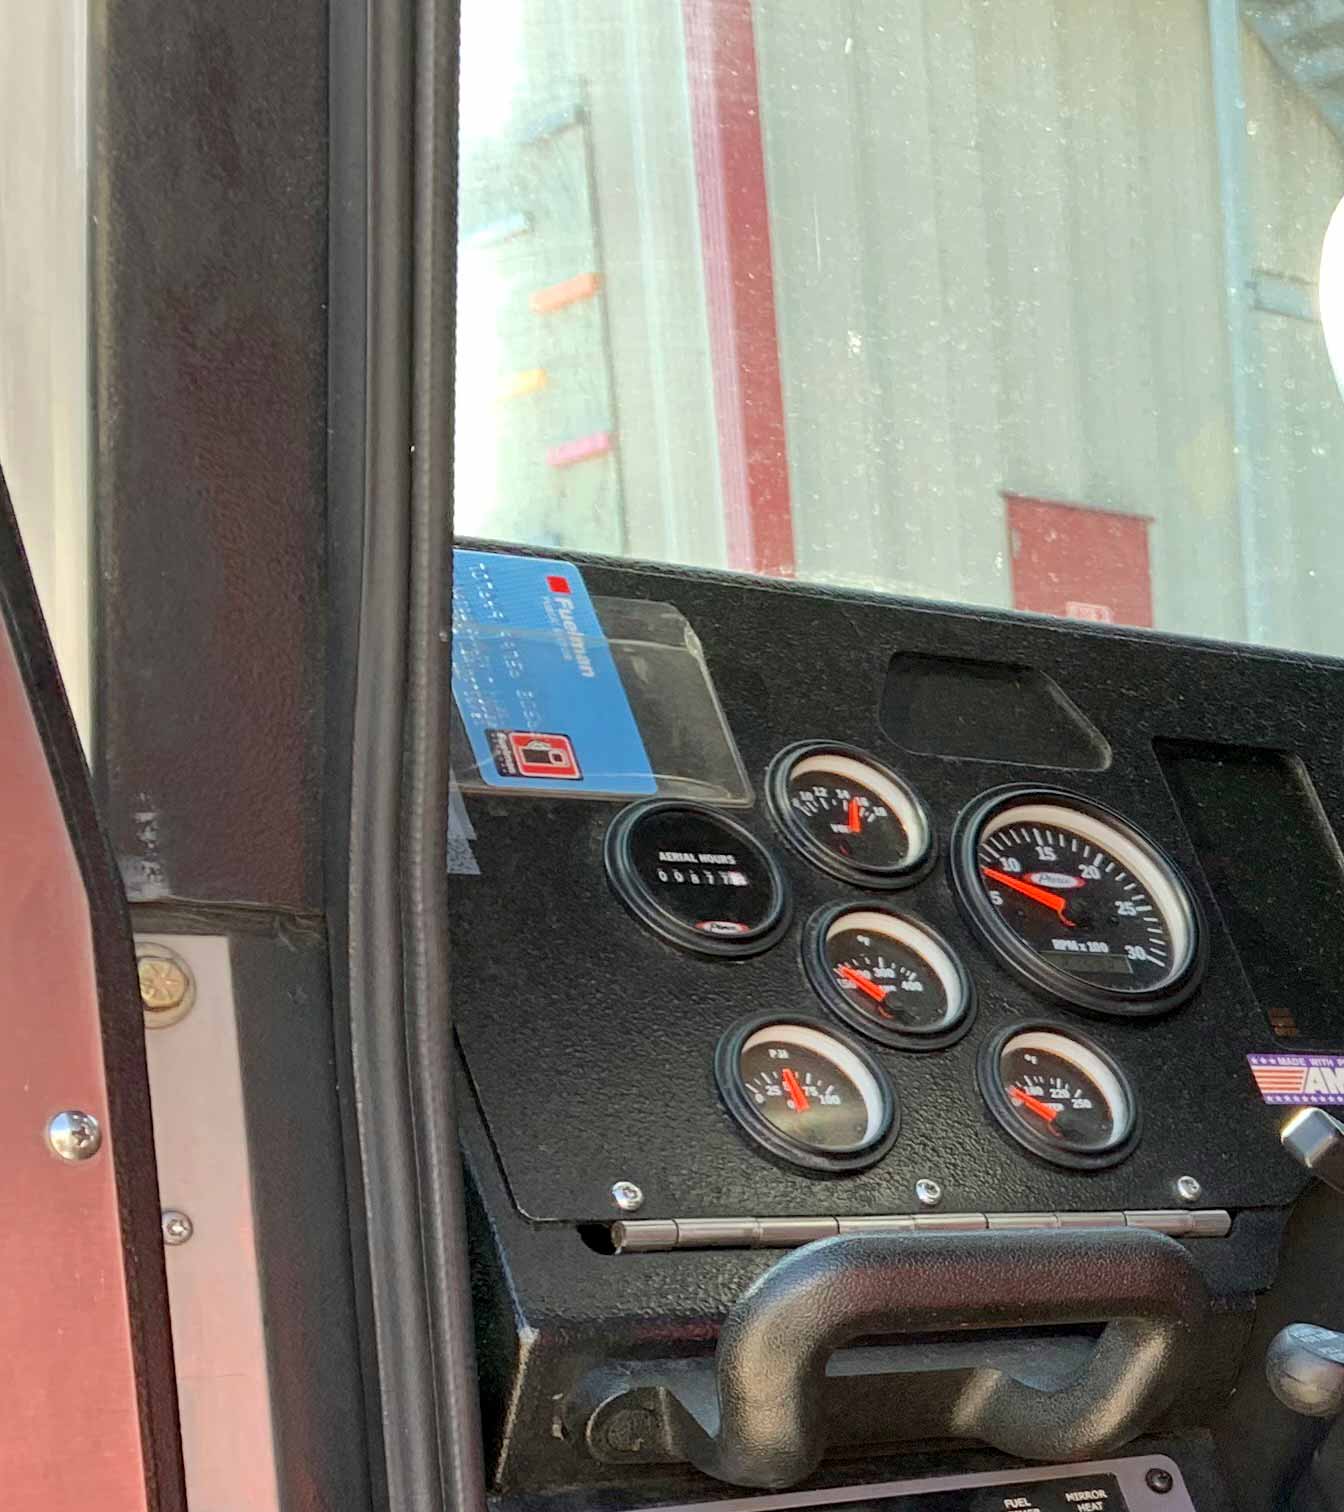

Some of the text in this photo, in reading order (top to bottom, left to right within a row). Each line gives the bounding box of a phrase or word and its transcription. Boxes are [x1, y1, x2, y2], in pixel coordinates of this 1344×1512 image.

[554, 597, 595, 678] Fuelman
[658, 851, 736, 865] AERIAL HOURS
[1035, 846, 1057, 861] 15
[1000, 857, 1021, 873] 10
[1078, 864, 1100, 879] 20
[989, 891, 1003, 906] 5
[1115, 901, 1137, 916] 25
[1051, 939, 1109, 953] RPM 100
[1124, 945, 1148, 961] 30
[1277, 1057, 1306, 1066] MADE
[1309, 1058, 1334, 1067] WITH
[765, 1085, 782, 1096] 25
[1065, 1489, 1108, 1502] MIRROR
[1003, 1497, 1031, 1509] FUEL
[1077, 1502, 1103, 1512] HEAT
